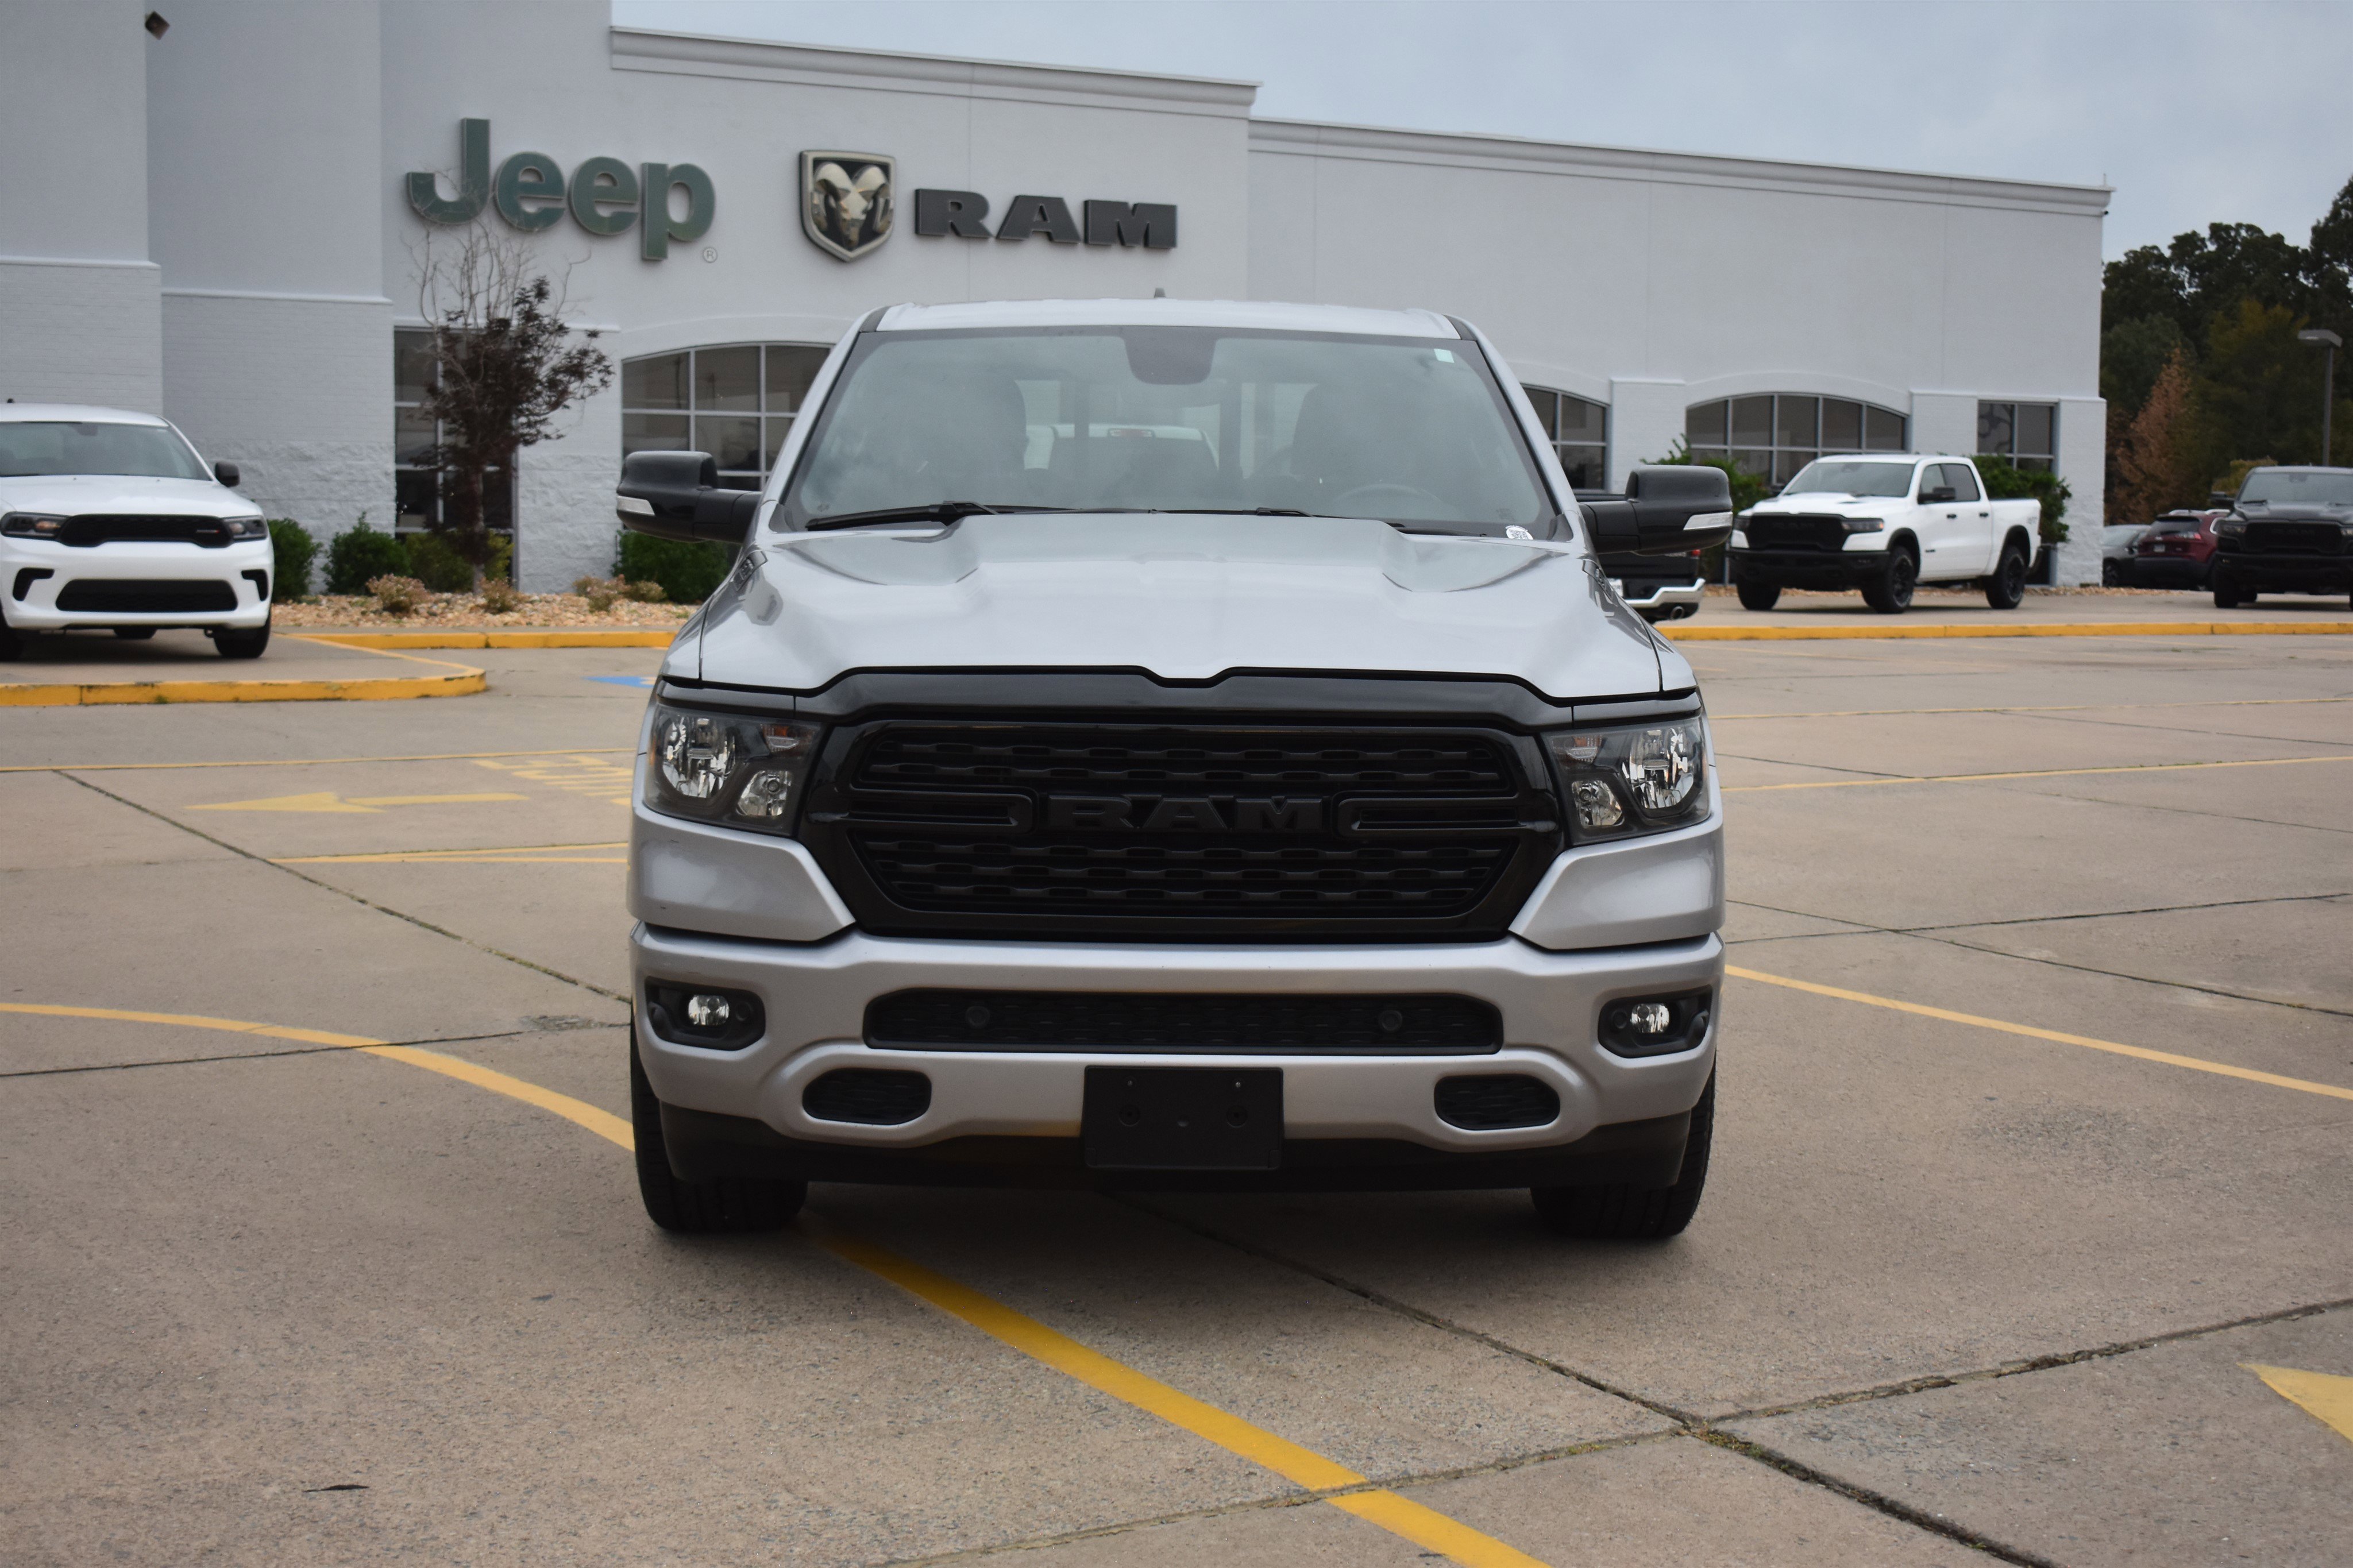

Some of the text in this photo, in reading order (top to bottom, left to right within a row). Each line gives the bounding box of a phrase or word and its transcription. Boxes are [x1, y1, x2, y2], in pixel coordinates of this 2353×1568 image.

[406, 117, 716, 260] Jeep
[914, 188, 1178, 249] RAM
[1048, 794, 1322, 830] RAM
